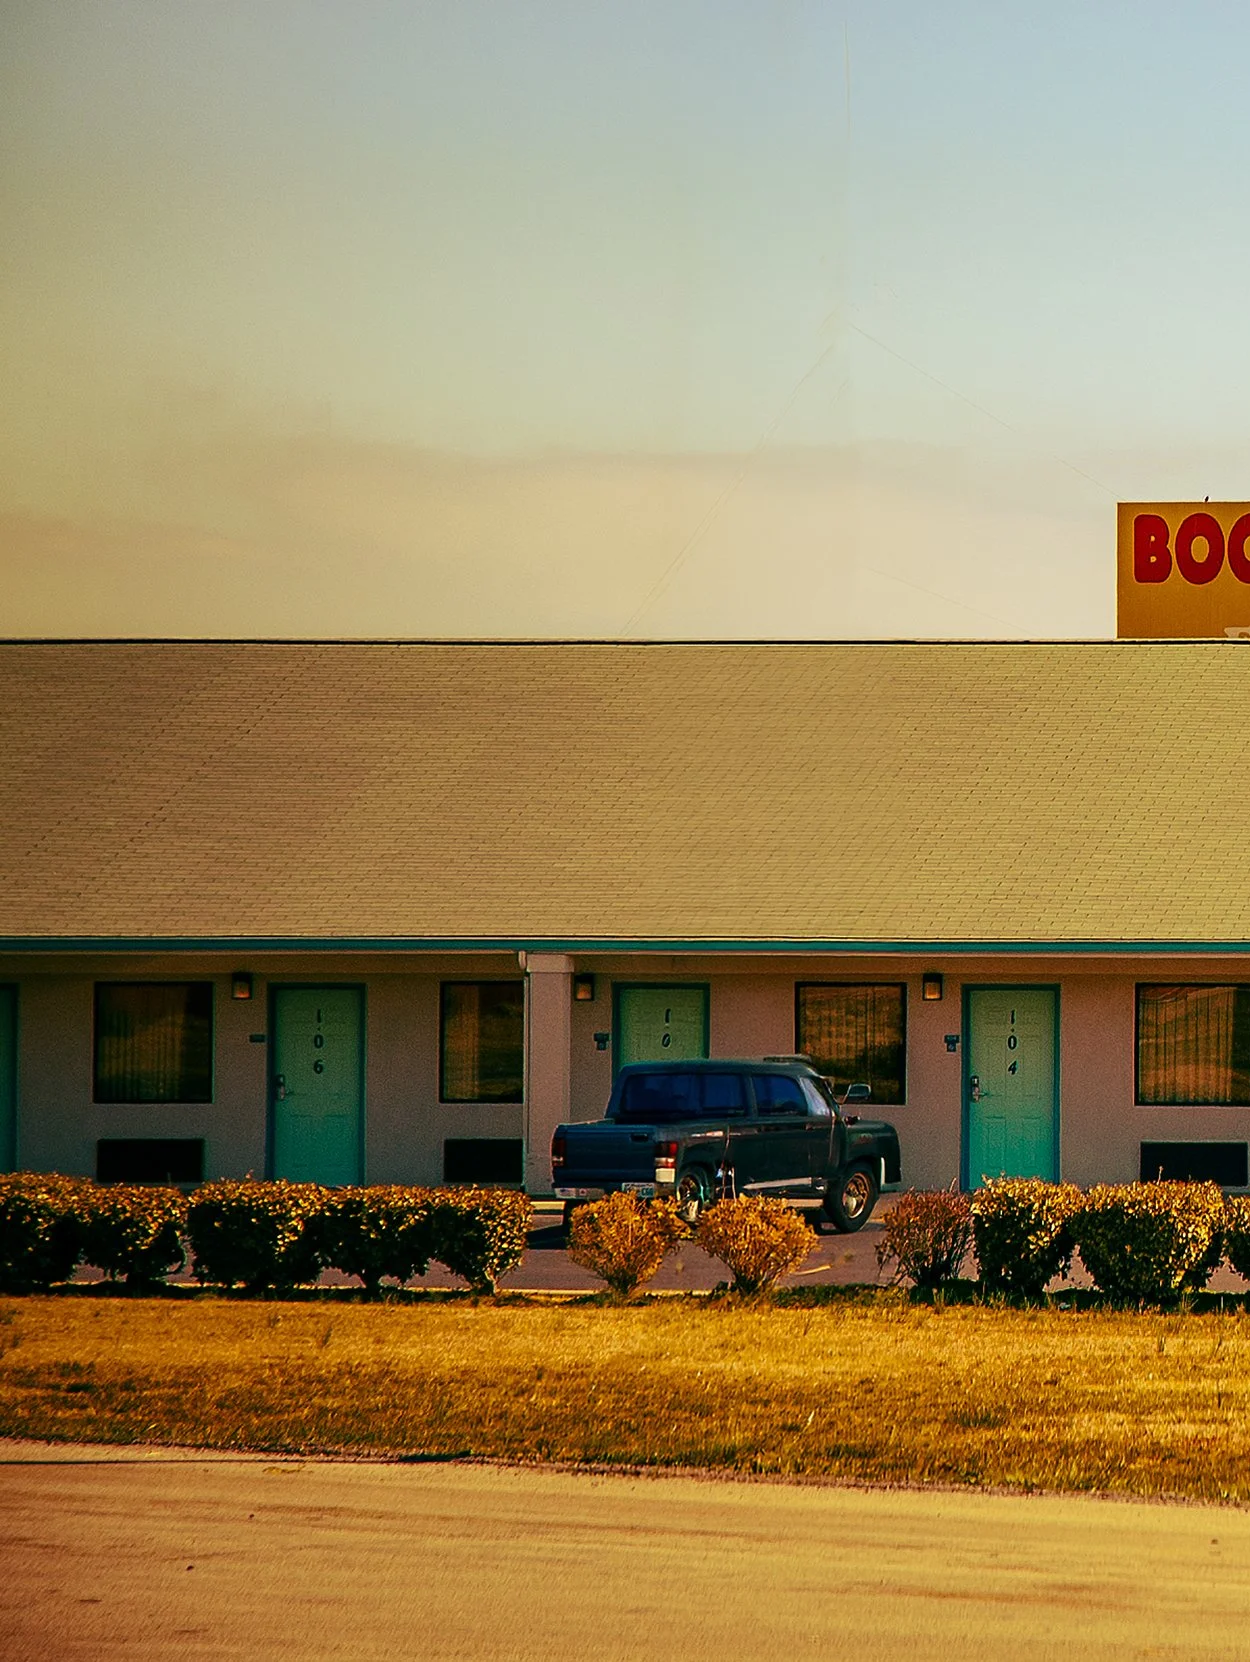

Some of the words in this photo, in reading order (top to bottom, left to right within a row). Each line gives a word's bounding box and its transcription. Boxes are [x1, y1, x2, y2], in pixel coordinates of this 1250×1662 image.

[314, 1008, 324, 1075] 106
[661, 1008, 671, 1048] 10
[1008, 1009, 1018, 1075] 104
